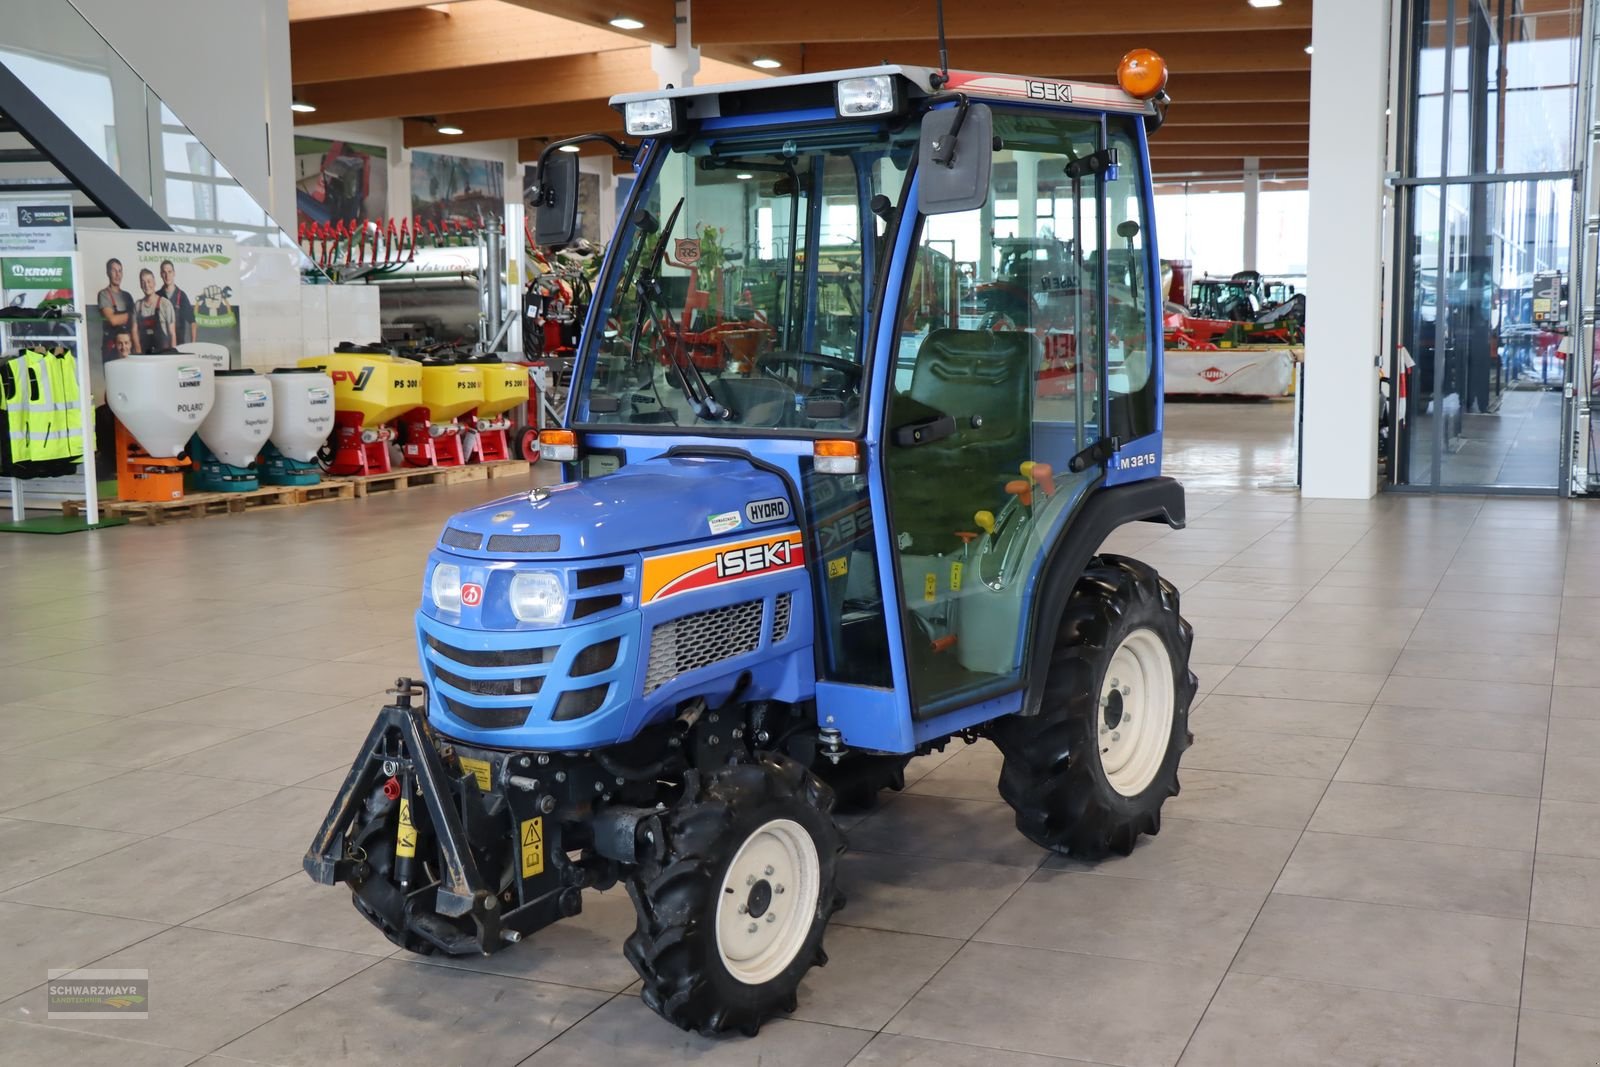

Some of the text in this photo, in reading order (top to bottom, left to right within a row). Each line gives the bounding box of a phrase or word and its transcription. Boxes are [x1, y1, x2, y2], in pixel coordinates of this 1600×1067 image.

[1025, 80, 1072, 103] ISEKI
[137, 241, 223, 254] SCHWARZMAYR
[139, 255, 190, 263] LANDTECHNIK
[24, 268, 63, 277] KRONE
[394, 380, 405, 388] PS
[407, 380, 418, 388] 300
[457, 381, 466, 389] PS
[1117, 453, 1156, 470] M3215
[750, 501, 785, 520] HYDRO
[715, 540, 791, 578] ISEKI
